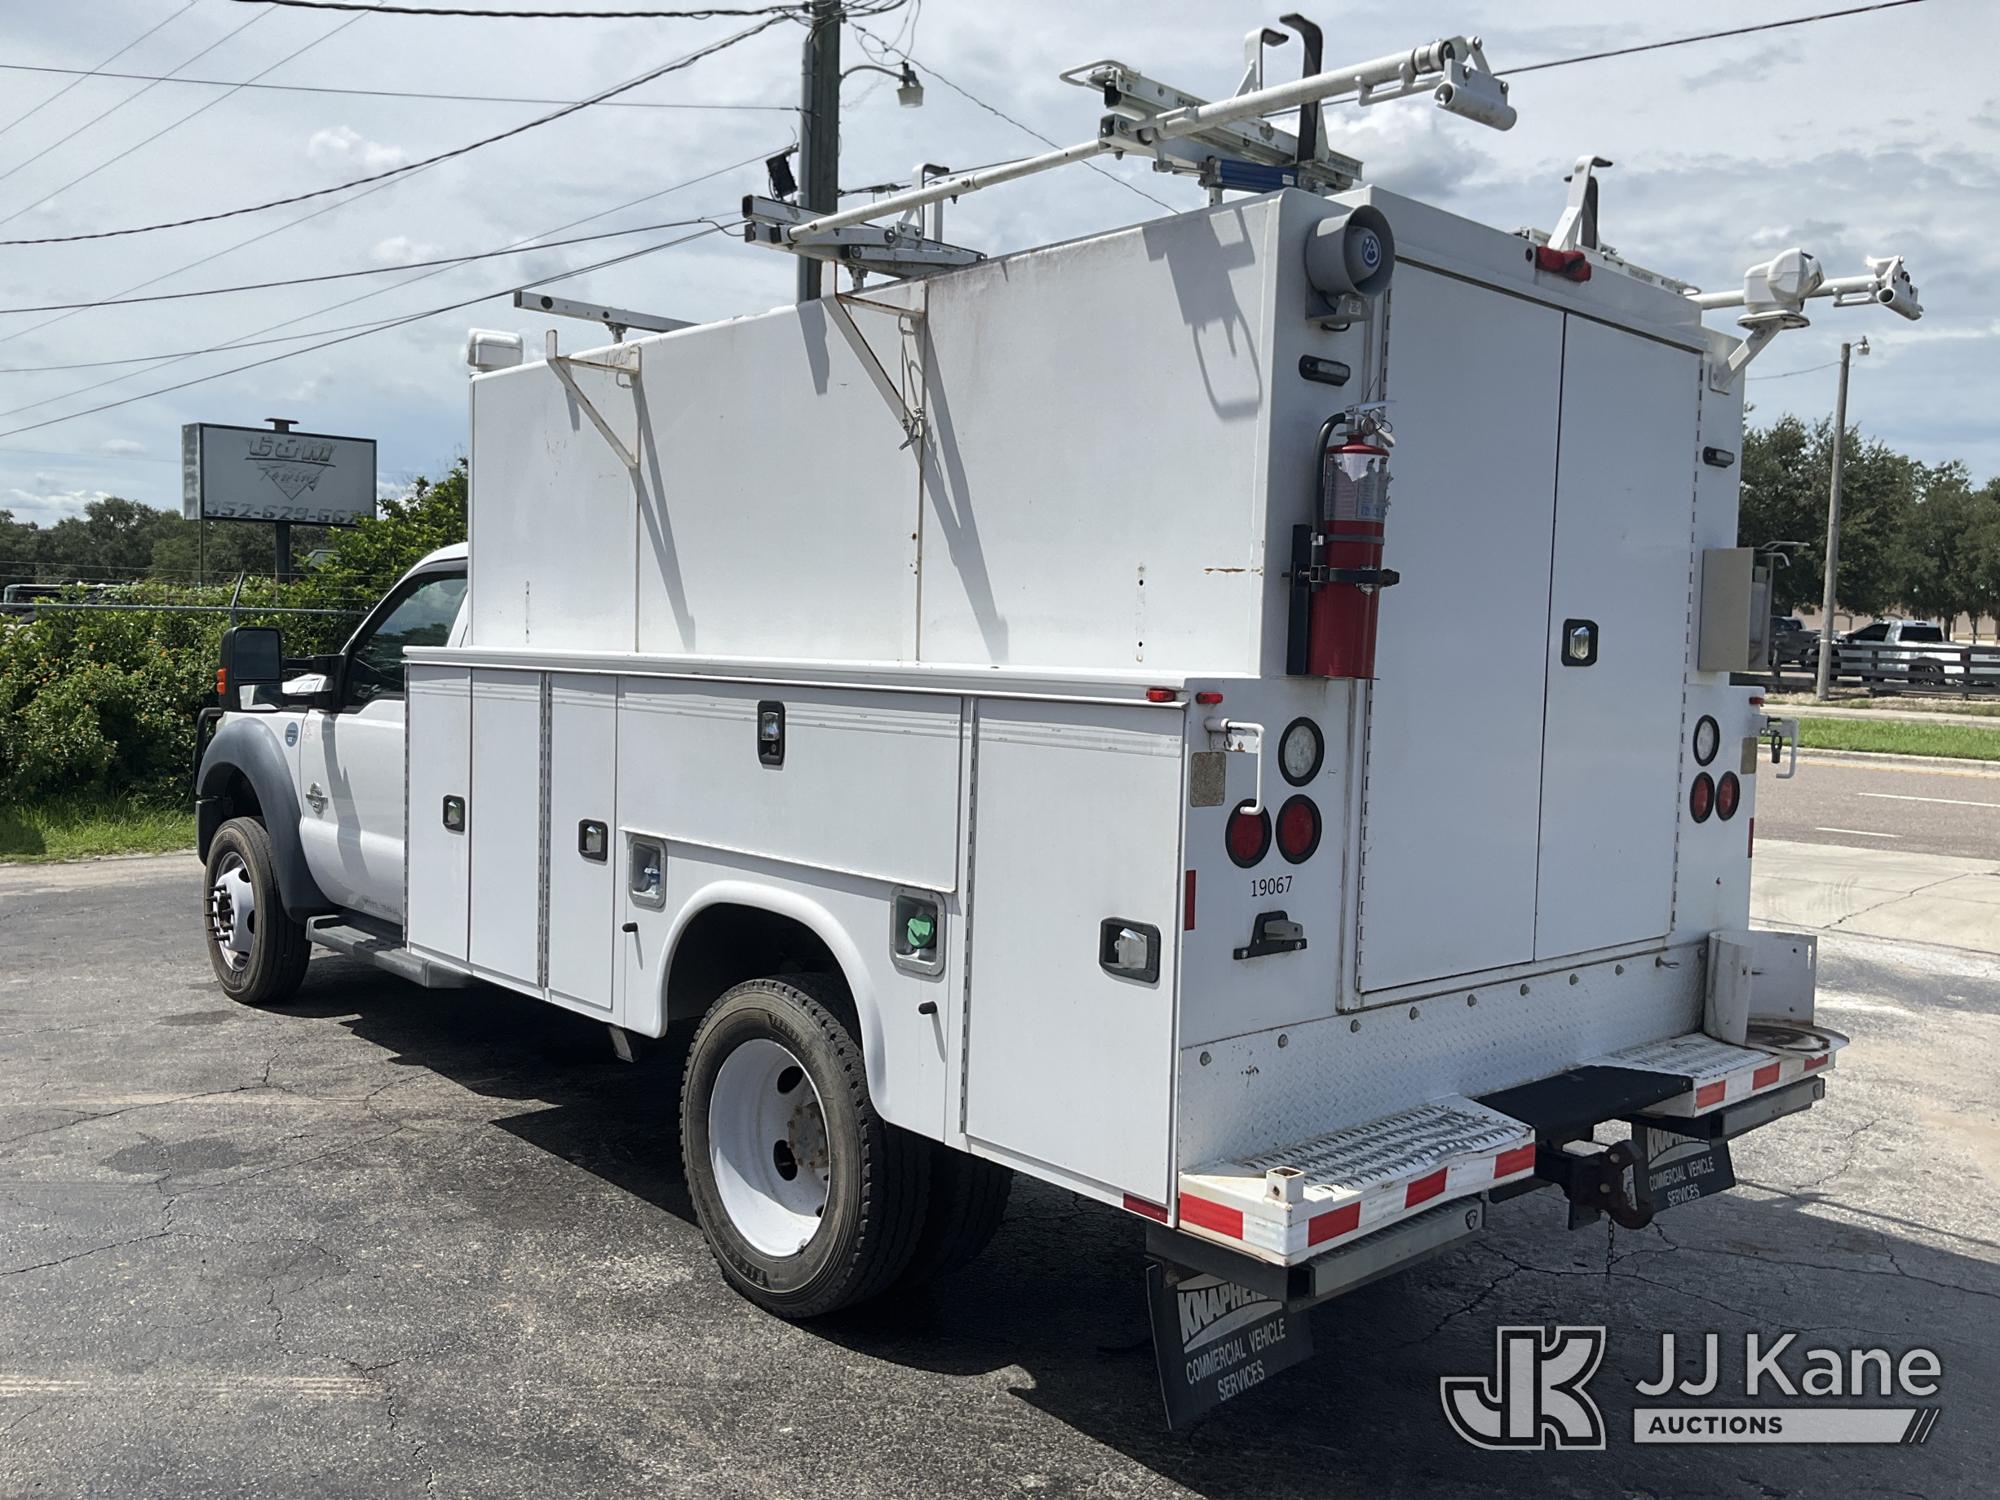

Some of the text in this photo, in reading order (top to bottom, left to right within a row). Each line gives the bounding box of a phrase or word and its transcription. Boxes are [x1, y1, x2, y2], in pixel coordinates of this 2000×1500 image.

[1251, 875, 1293, 897] 19067
[1649, 1156, 1715, 1192] COMMERCIAL VEHICLE
[1667, 1184, 1700, 1207] SERVICES
[1186, 1318, 1286, 1385] COMMERCIAL VEHICLE
[1217, 1360, 1265, 1401] SERVICES
